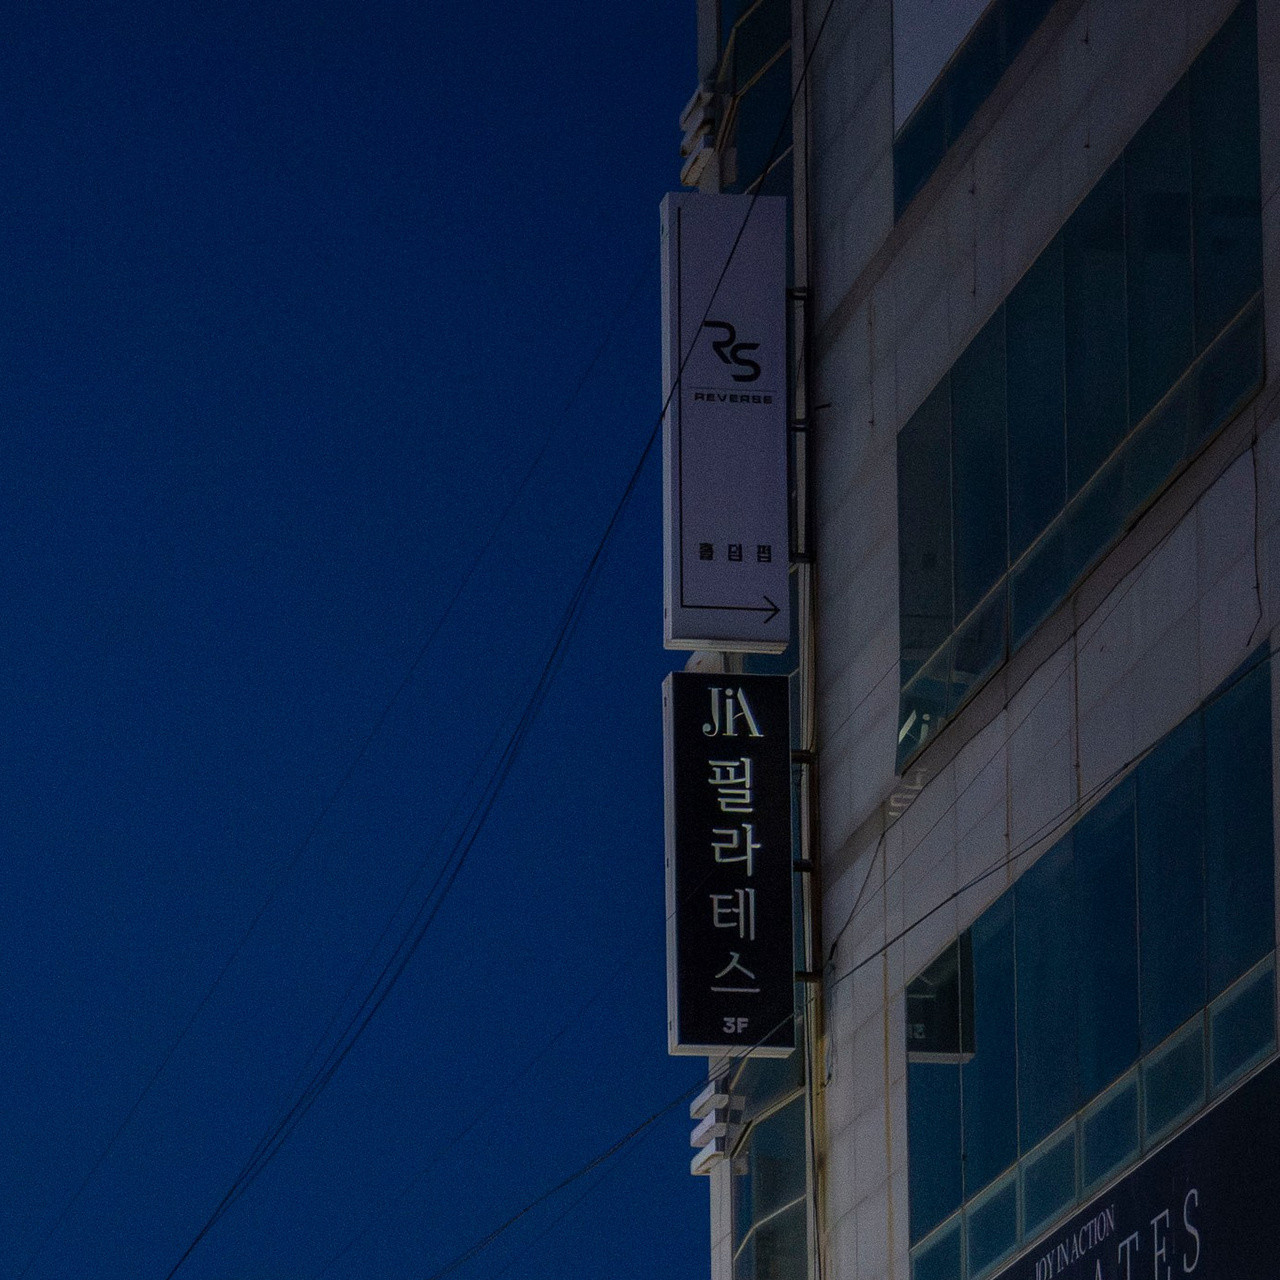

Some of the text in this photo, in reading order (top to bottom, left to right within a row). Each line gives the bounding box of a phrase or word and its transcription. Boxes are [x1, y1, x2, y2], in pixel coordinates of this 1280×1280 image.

[694, 392, 773, 404] REVERSE
[707, 756, 762, 994] 필라테스
[722, 1016, 749, 1035] 3F
